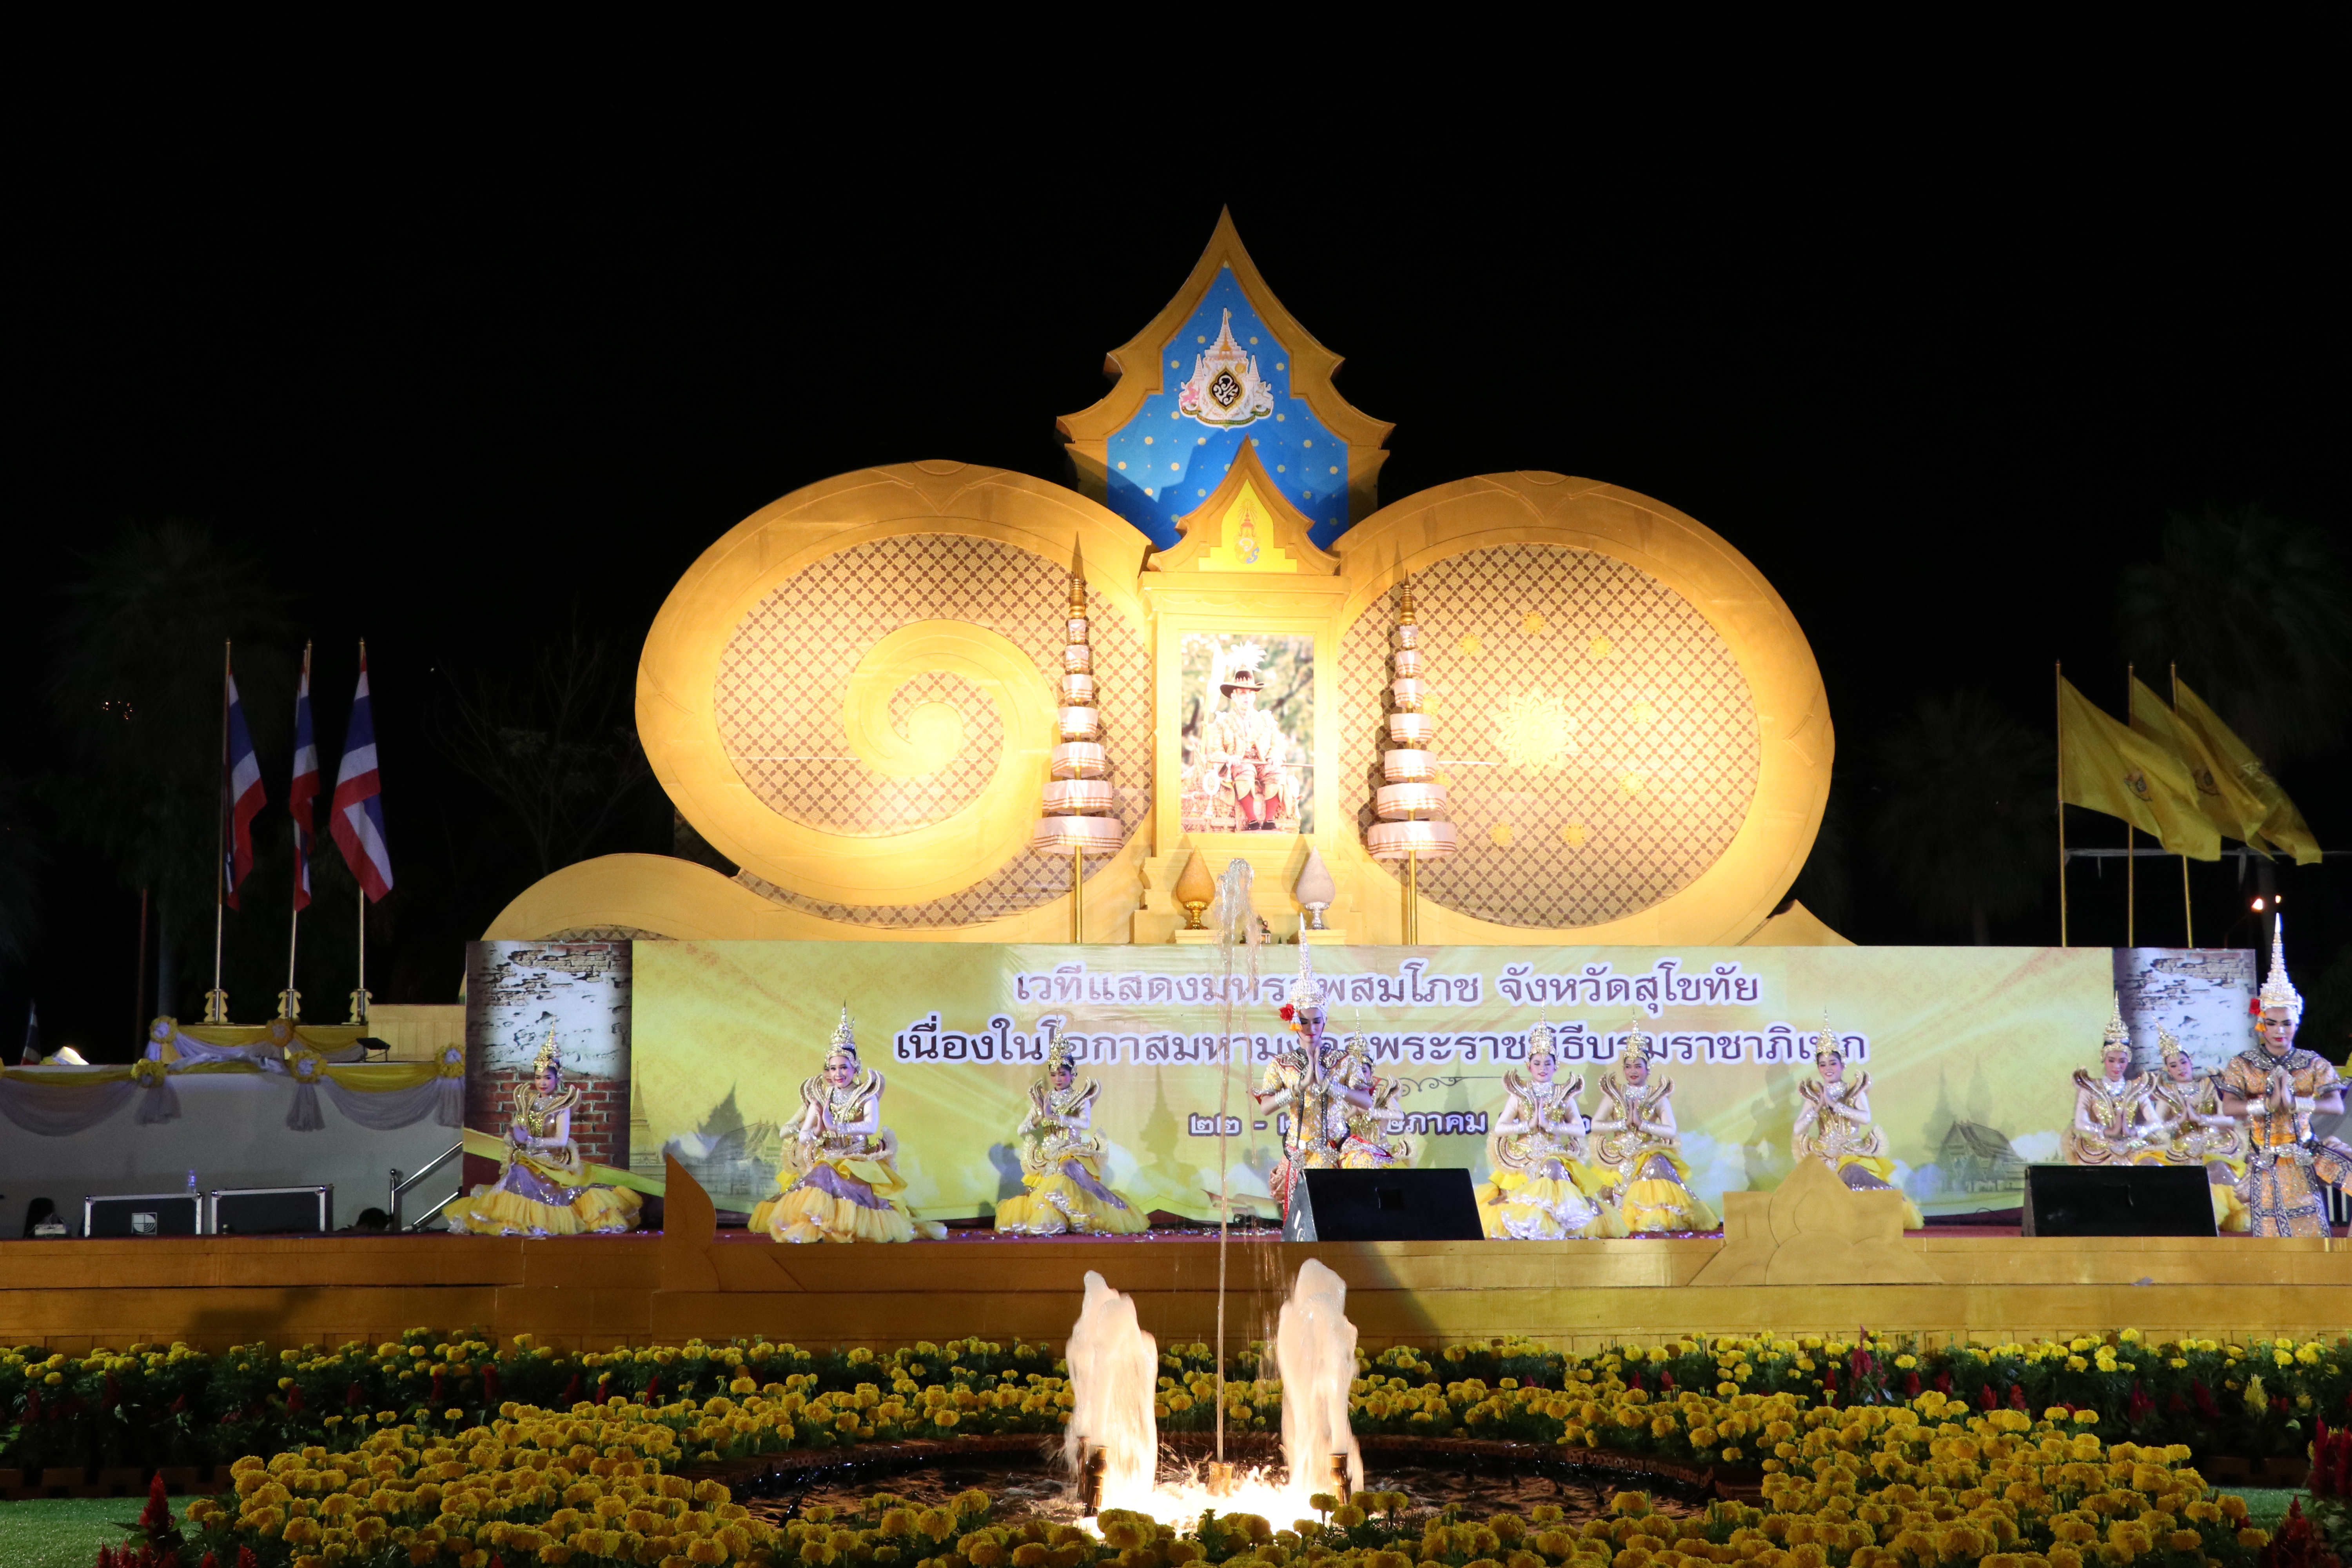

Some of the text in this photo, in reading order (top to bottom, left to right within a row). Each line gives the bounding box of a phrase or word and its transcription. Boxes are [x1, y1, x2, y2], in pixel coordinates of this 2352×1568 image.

[1018, 961, 1758, 1014] เวทีแสดงมหรพสมโภช จังหวัดสุโขทัย
[1191, 1114, 1240, 1133] ๒๒
